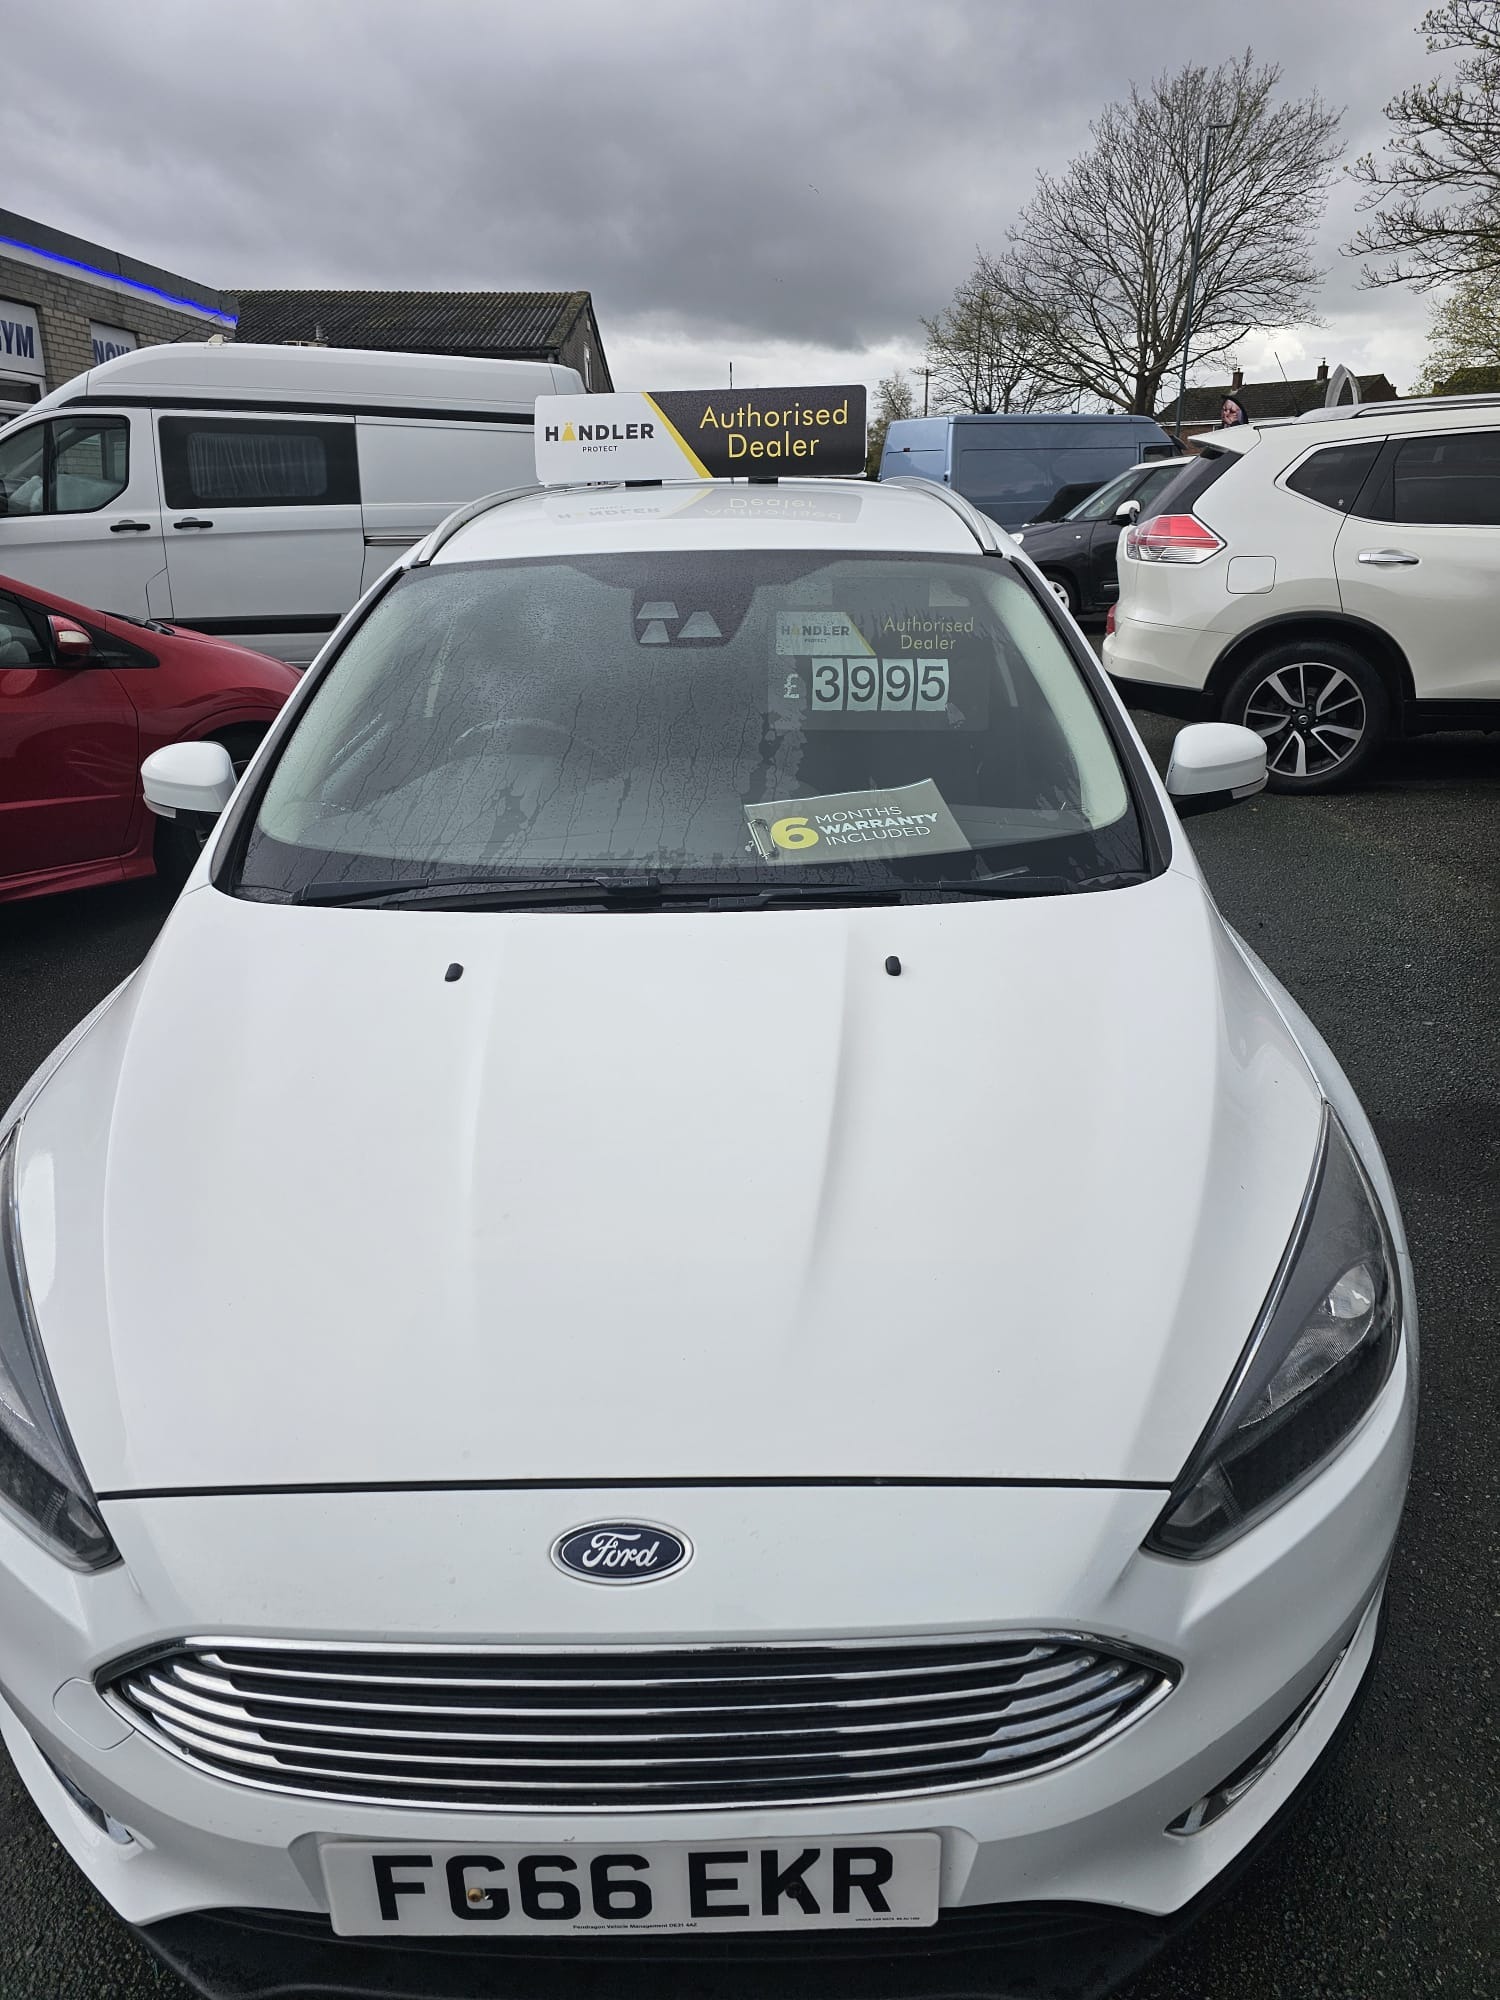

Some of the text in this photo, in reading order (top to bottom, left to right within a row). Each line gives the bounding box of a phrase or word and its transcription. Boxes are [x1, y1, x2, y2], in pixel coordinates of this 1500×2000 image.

[0, 319, 35, 359] YM
[699, 399, 848, 429] Authorised
[728, 432, 819, 458] Dealer
[883, 616, 974, 633] Authorised
[901, 635, 956, 650] Dealer
[815, 665, 946, 703] 3995
[815, 806, 903, 824] MONTHS
[818, 812, 939, 836] WARRANTY
[770, 817, 819, 850] 6
[824, 826, 931, 846] INCLUDED
[582, 1532, 661, 1568] Ford
[371, 1846, 893, 1921] FG66 EKR
